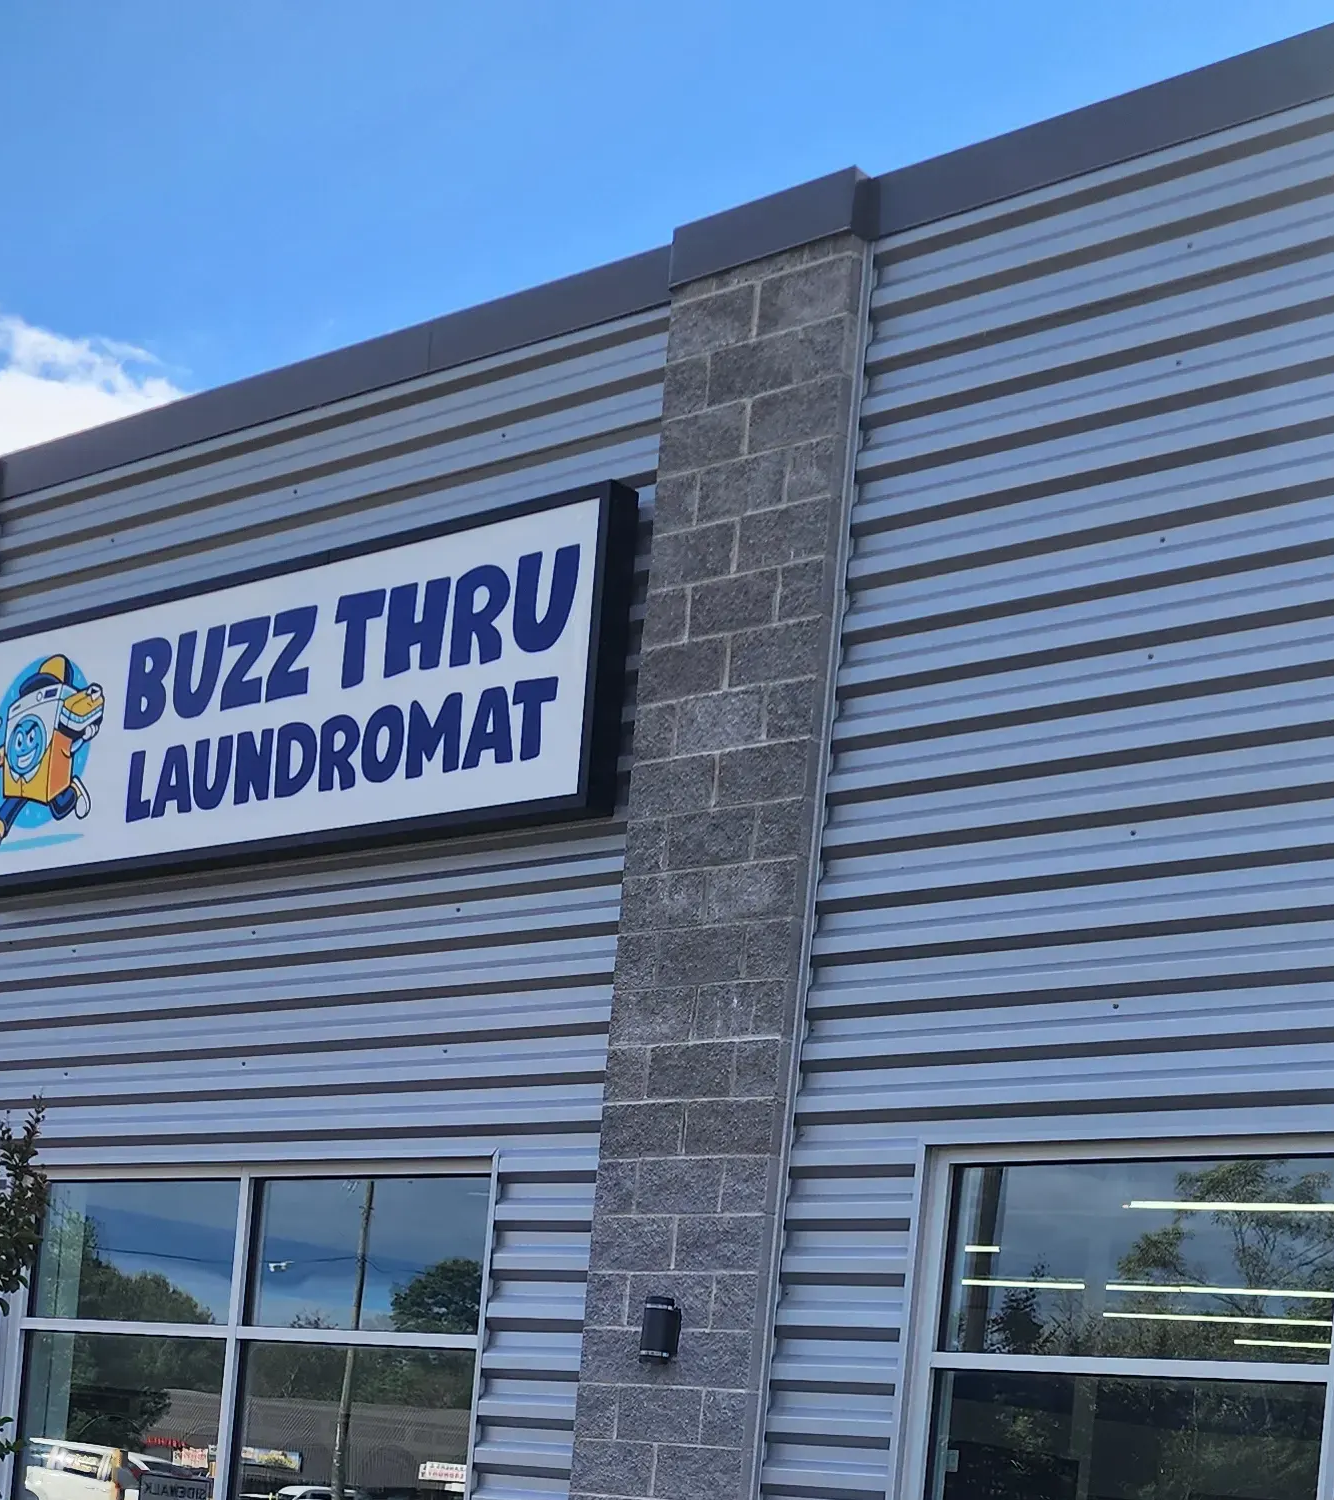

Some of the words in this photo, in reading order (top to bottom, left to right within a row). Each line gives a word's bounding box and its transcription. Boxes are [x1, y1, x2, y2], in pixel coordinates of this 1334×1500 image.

[124, 605, 318, 730] BUZZ
[334, 544, 581, 690] THRU
[125, 677, 558, 823] LAUNDROMAT
